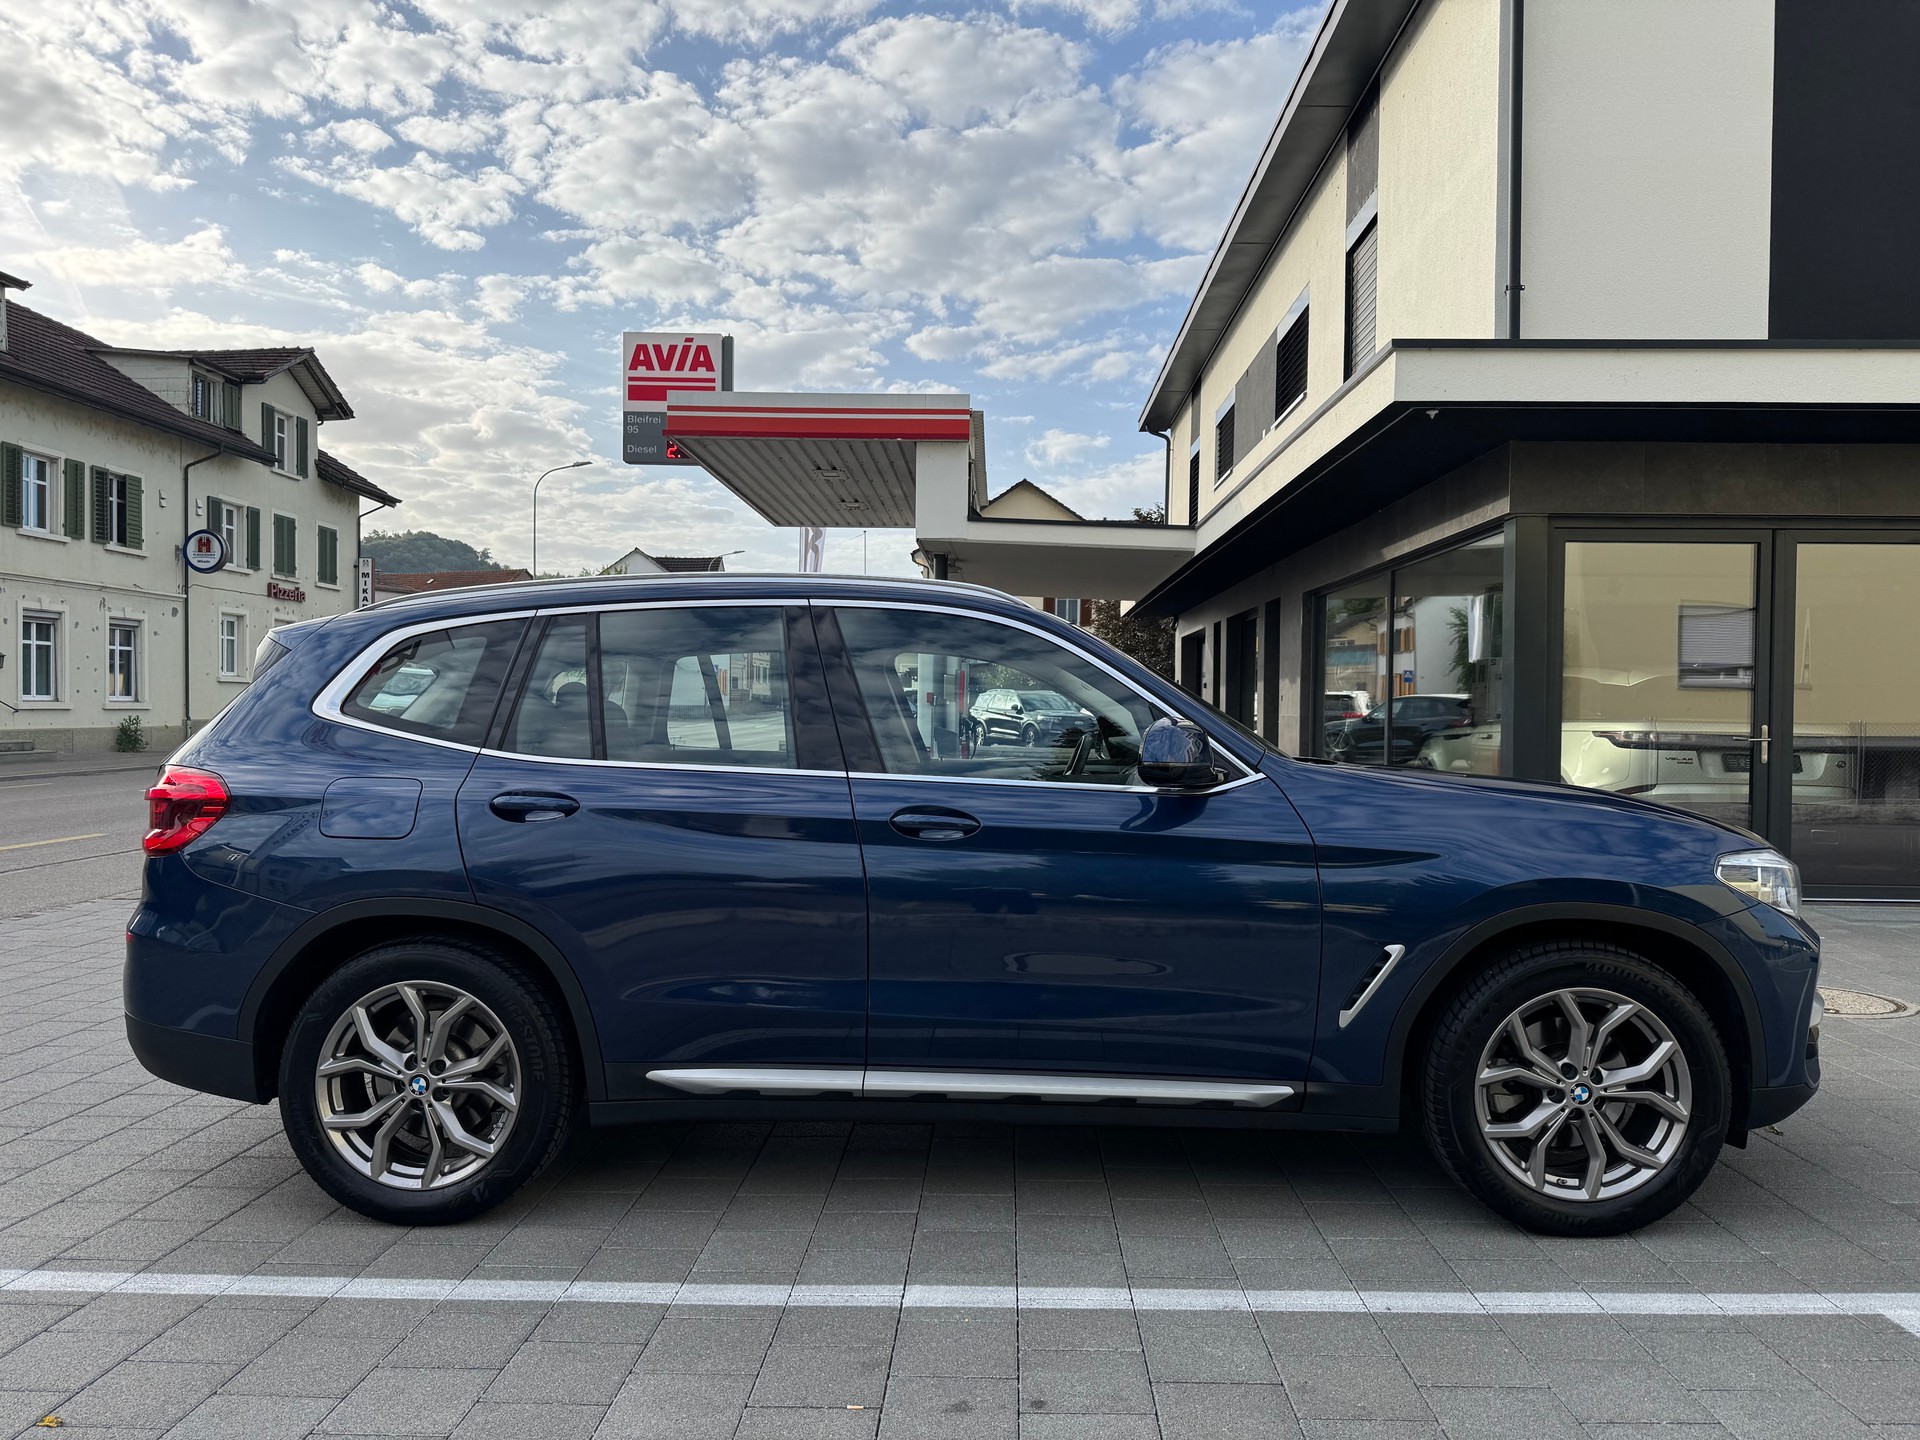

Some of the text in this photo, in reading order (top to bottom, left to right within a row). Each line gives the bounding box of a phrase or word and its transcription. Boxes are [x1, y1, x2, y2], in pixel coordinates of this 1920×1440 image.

[627, 415, 662, 424] Bleifrei
[627, 425, 639, 434] 95
[627, 445, 657, 454] Diesel
[268, 582, 306, 602] Pizzeria
